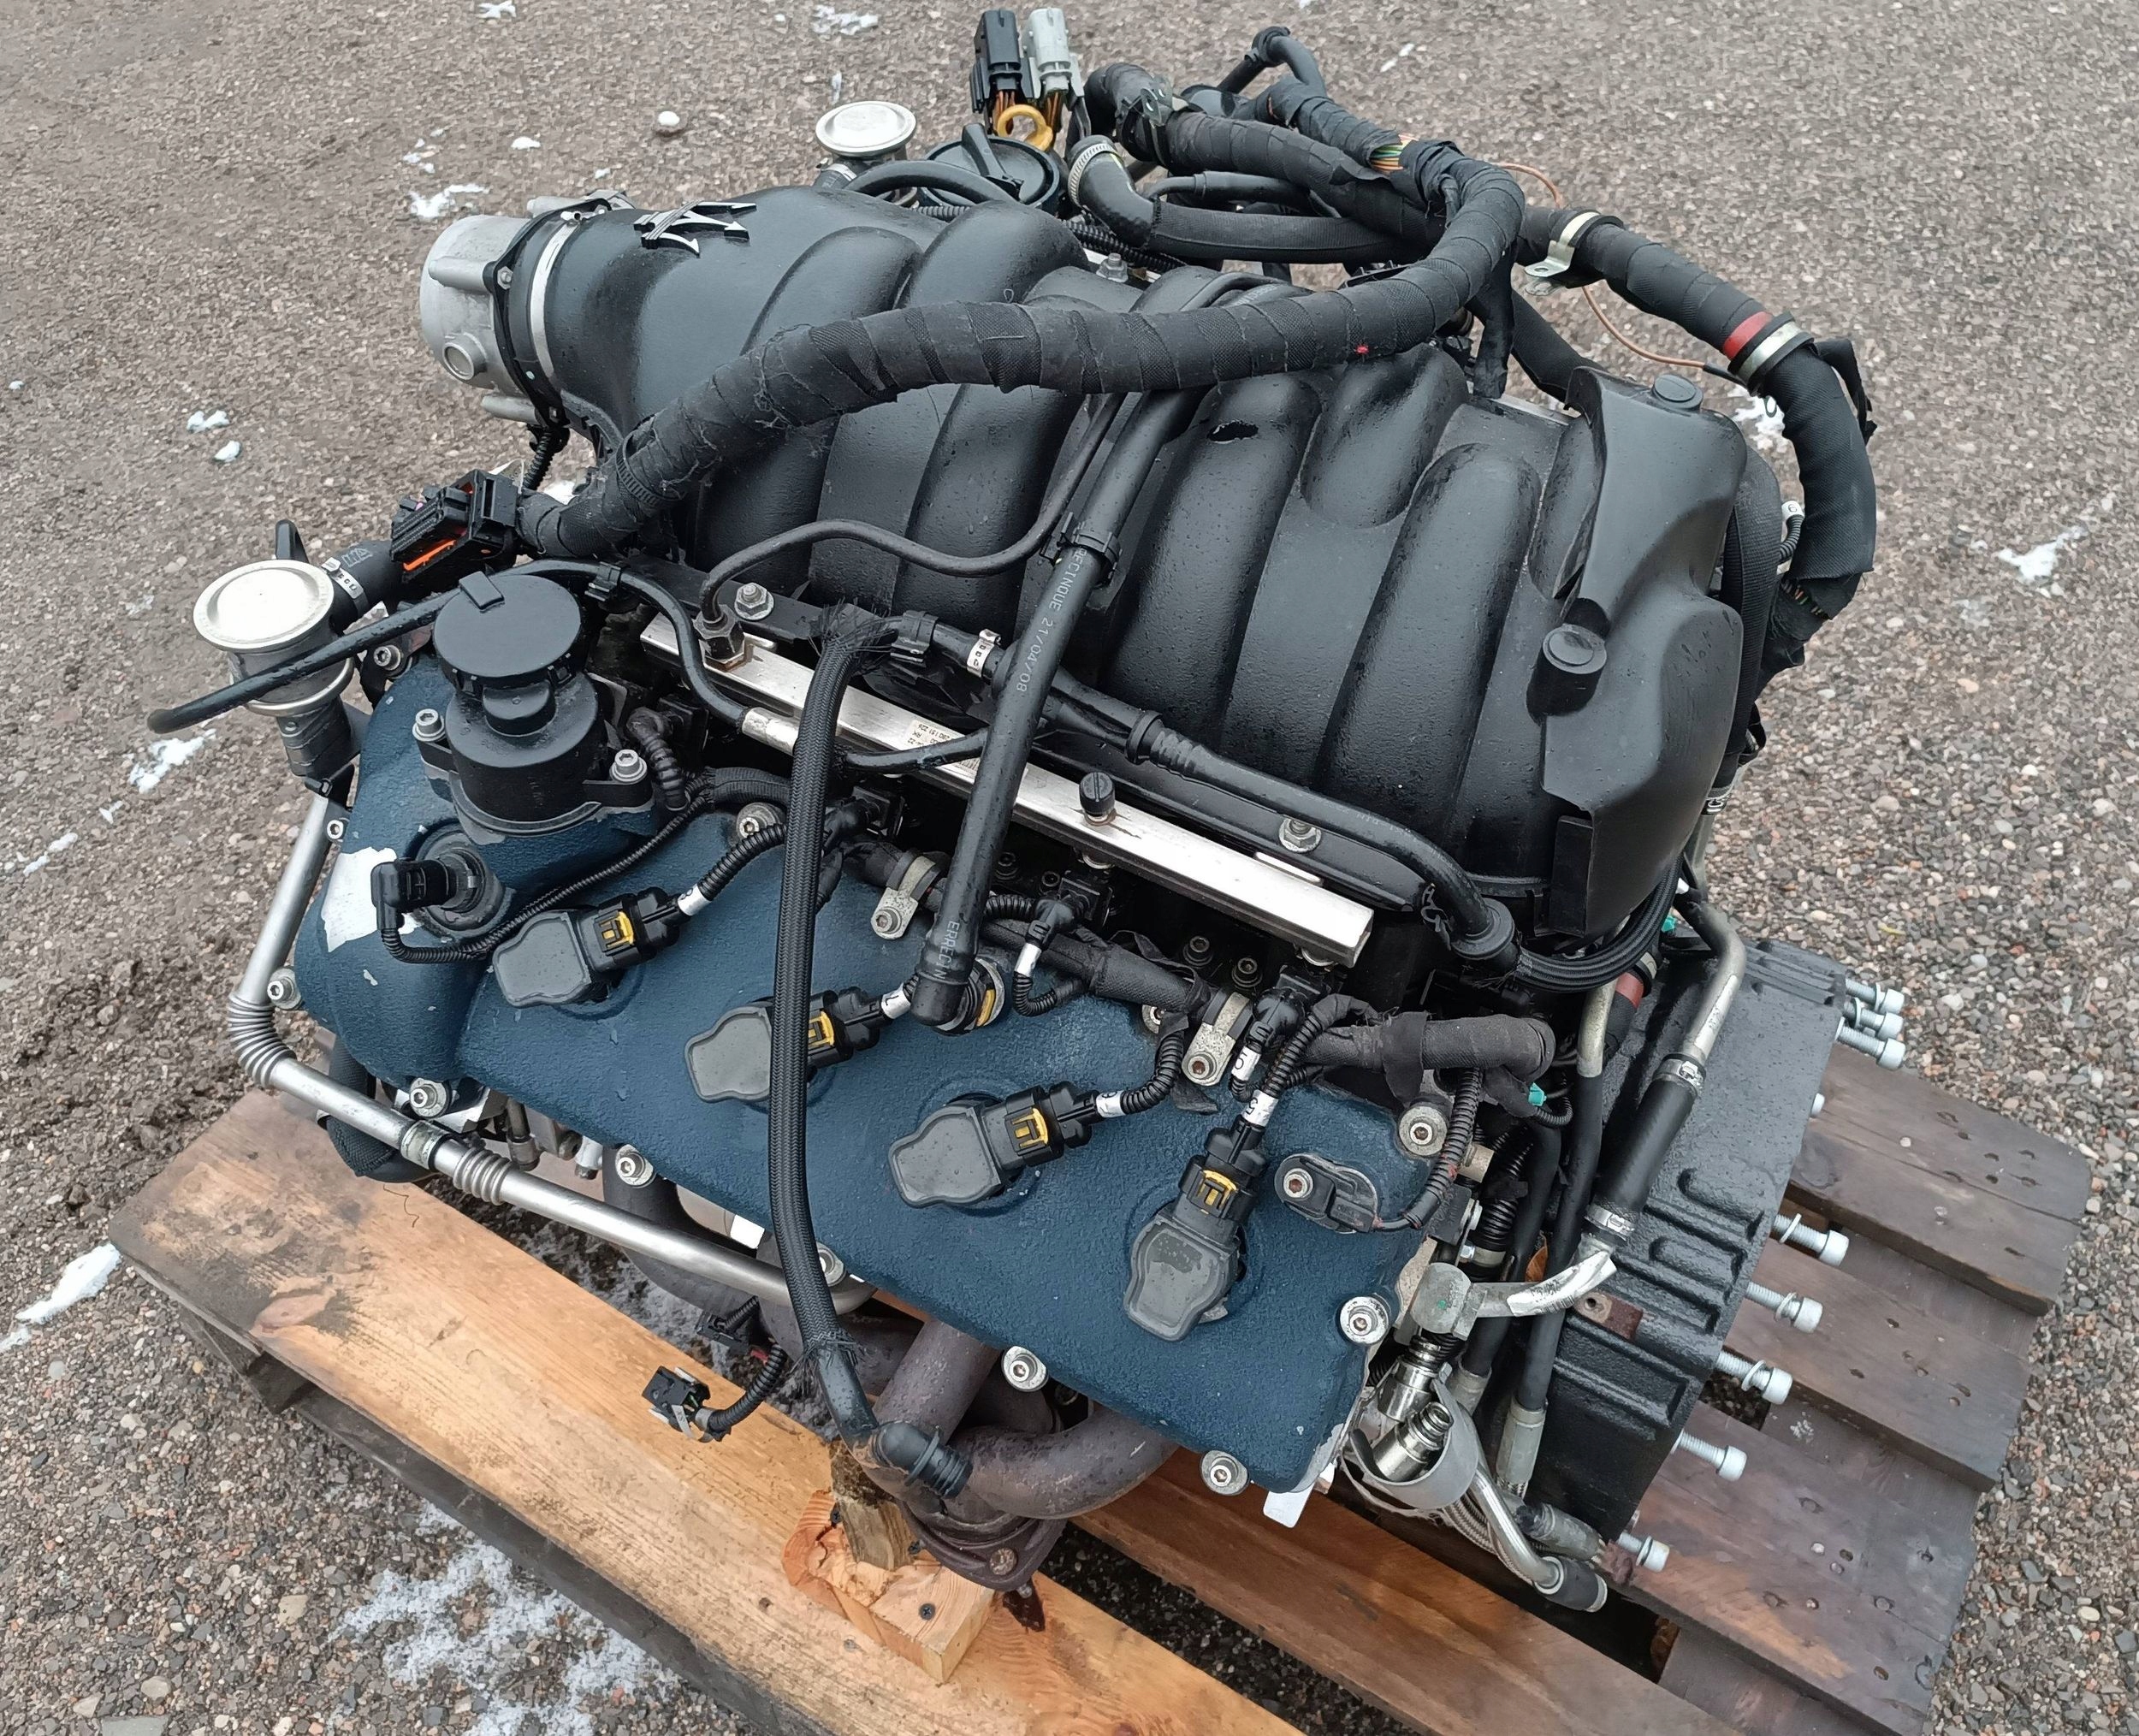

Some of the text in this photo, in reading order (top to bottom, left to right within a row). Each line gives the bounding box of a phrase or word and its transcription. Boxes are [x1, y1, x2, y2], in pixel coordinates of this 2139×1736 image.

[1016, 617, 1053, 692] 21/04/08
[933, 921, 960, 980] ERRECIN
[1246, 1097, 1259, 1115] 5
